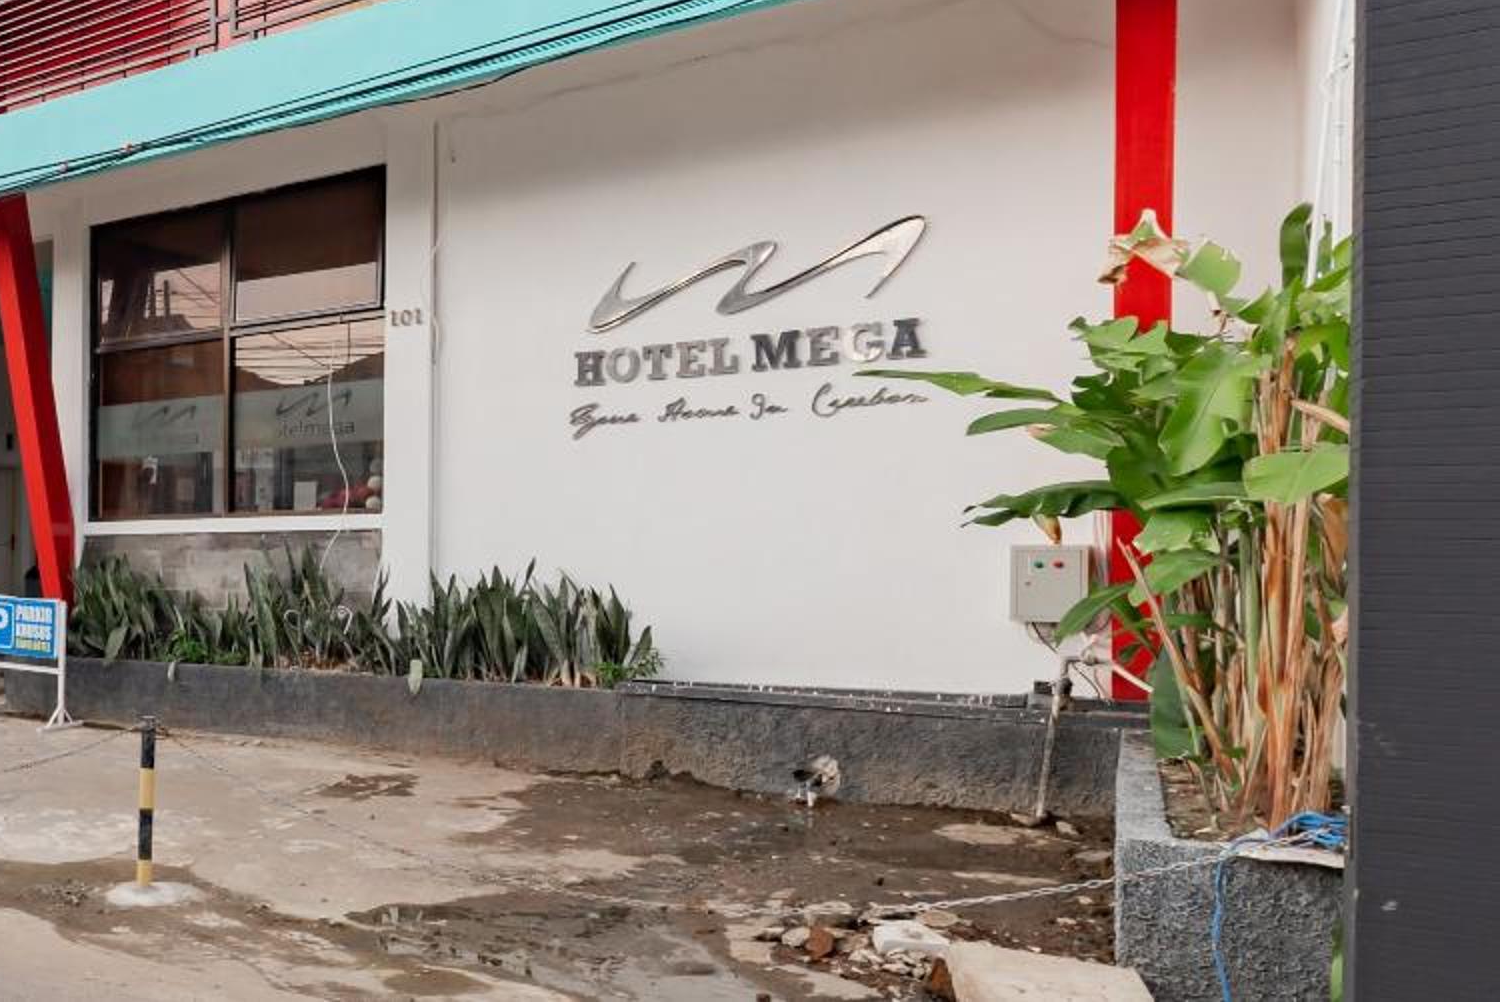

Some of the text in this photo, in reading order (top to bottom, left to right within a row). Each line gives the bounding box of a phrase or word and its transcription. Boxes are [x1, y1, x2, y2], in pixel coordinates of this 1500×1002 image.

[390, 308, 423, 327] 101
[573, 317, 927, 387] HOTEL MEGA
